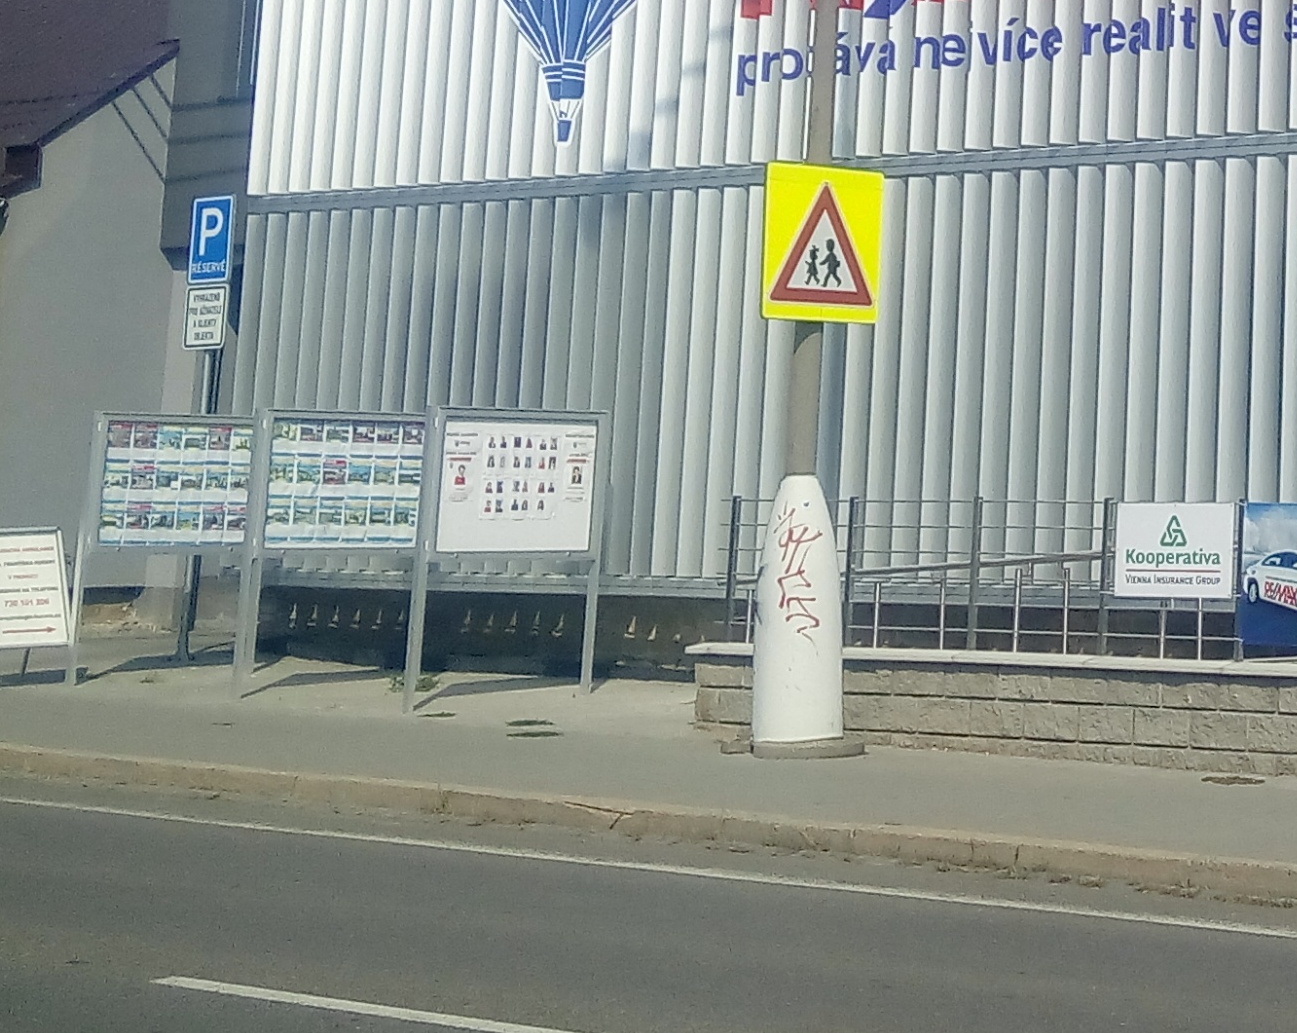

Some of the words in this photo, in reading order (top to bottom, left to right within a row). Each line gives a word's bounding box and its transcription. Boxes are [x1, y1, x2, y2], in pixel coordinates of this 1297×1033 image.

[736, 31, 897, 97] proává
[913, 17, 1064, 73] nevíce
[1081, 3, 1197, 56] realit
[1213, 8, 1262, 48] ve
[199, 207, 224, 256] P
[1125, 547, 1222, 568] Kooperativa
[1195, 575, 1221, 586] GROUP
